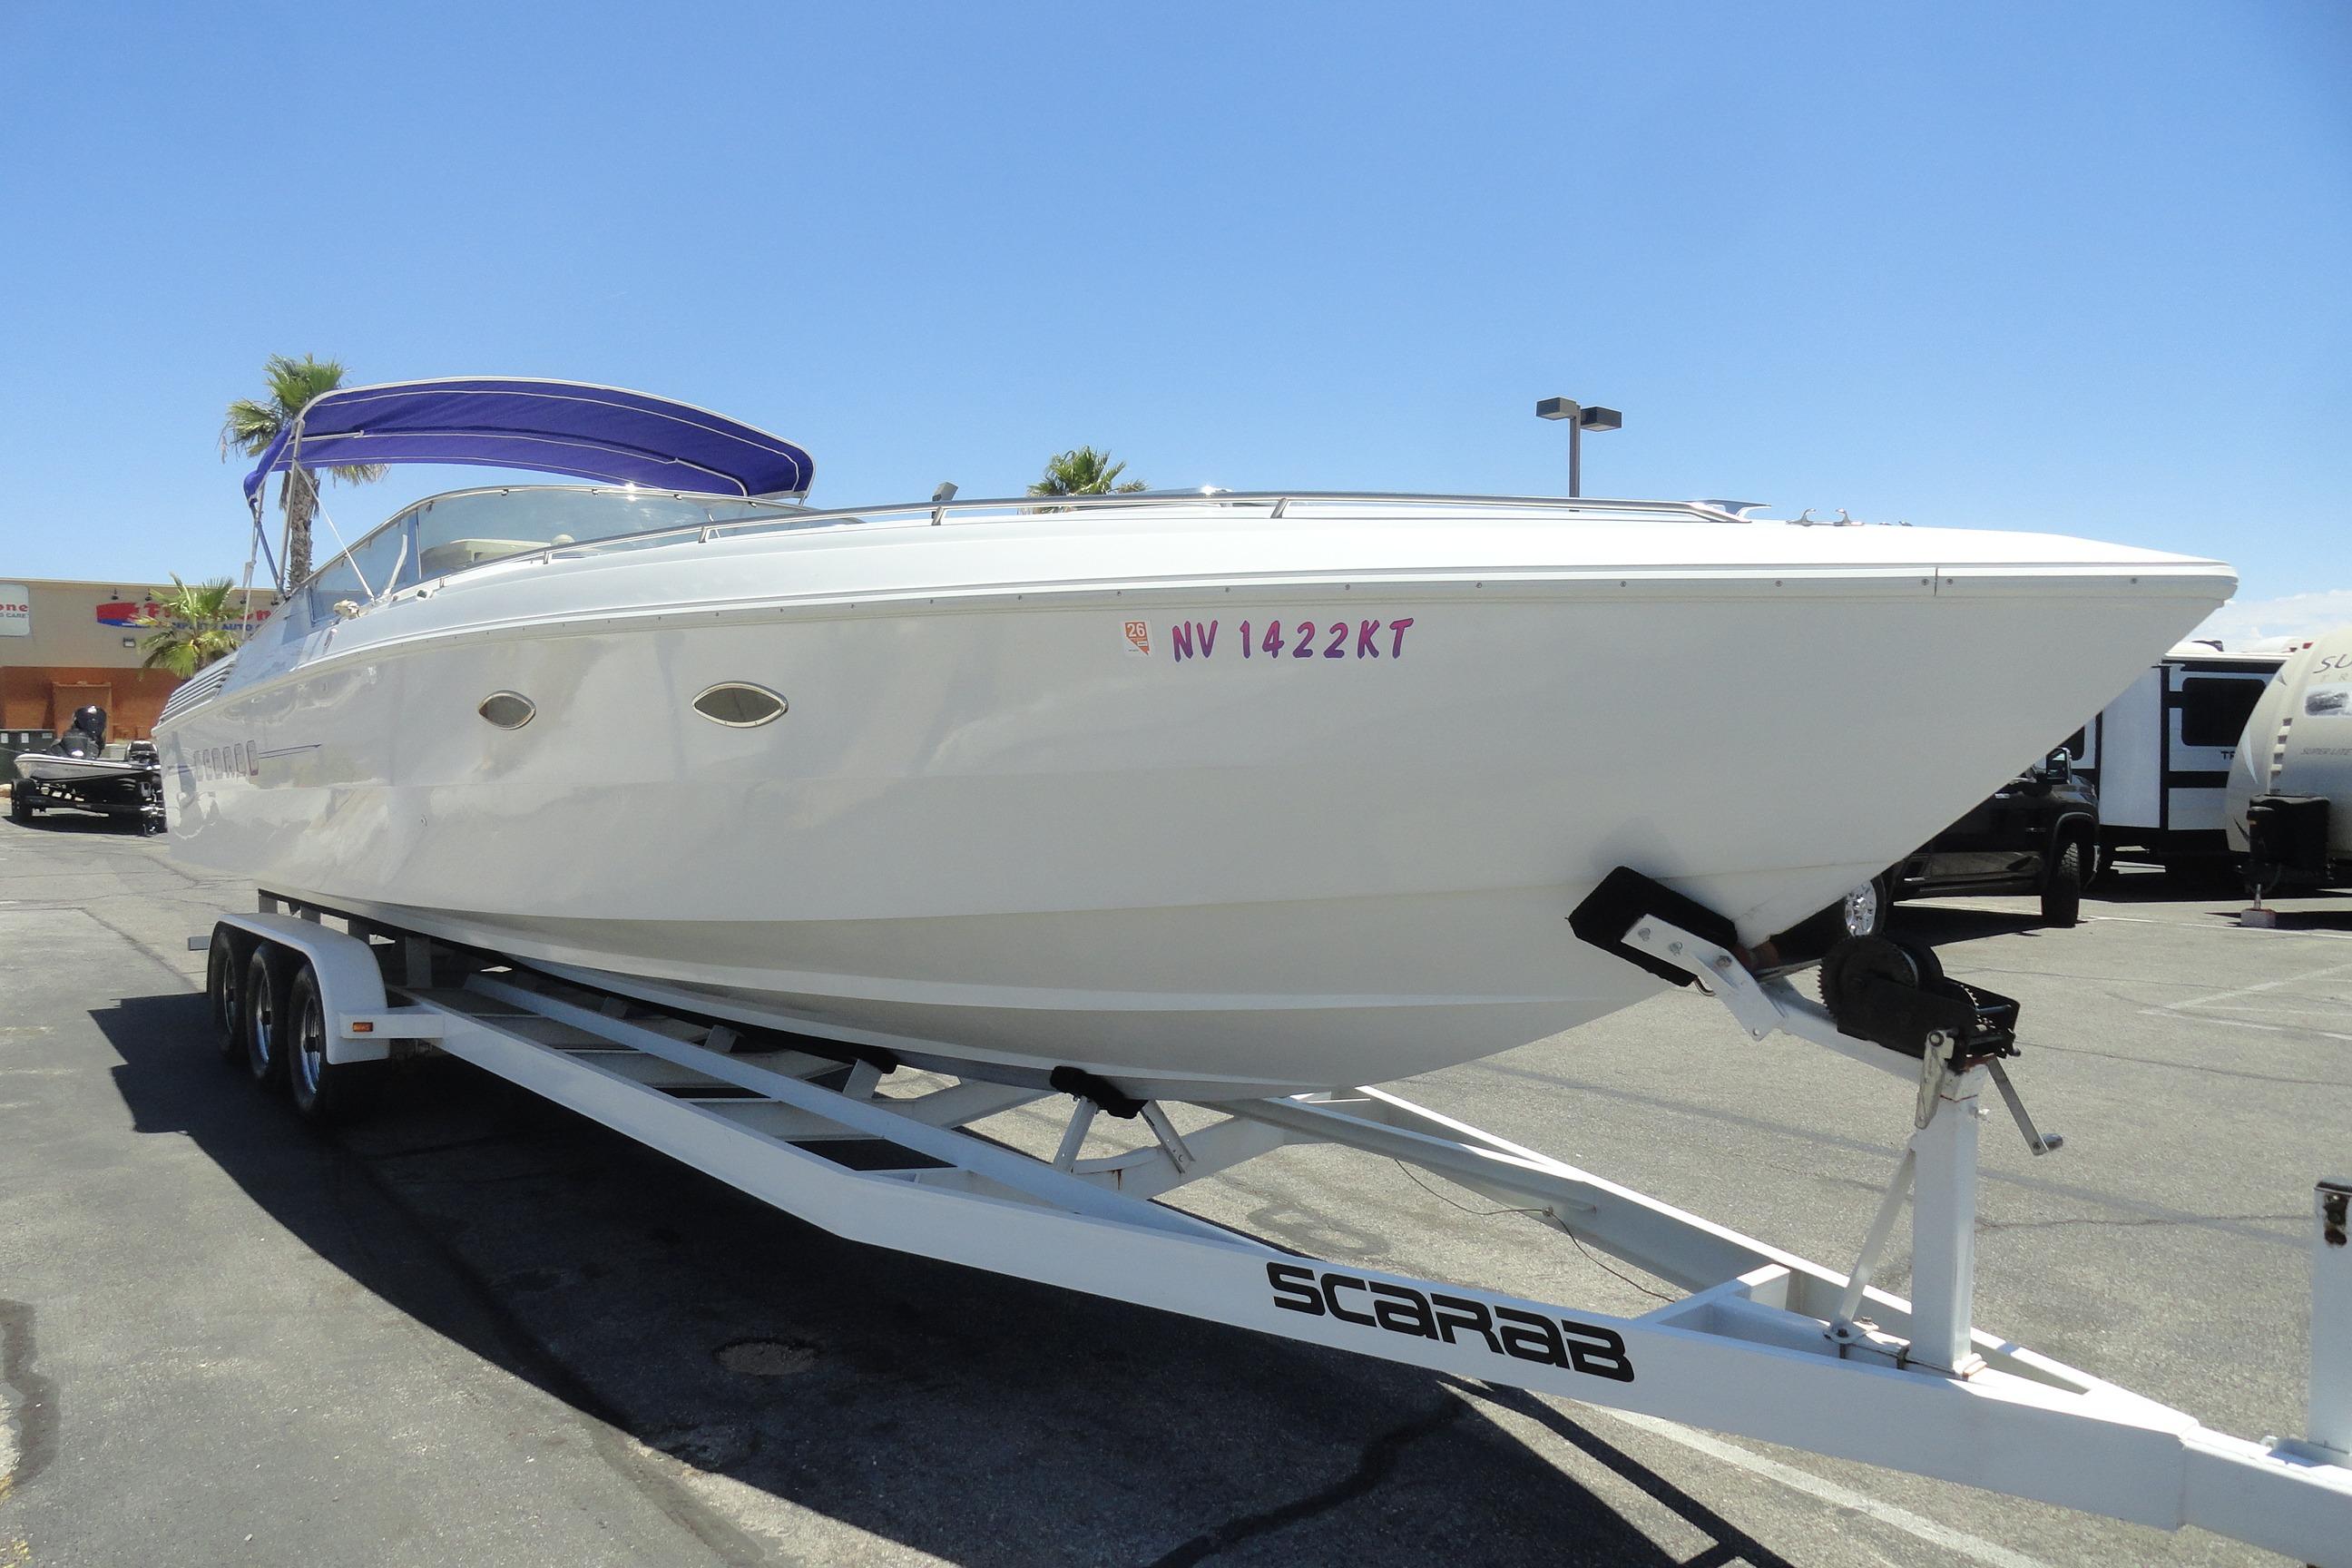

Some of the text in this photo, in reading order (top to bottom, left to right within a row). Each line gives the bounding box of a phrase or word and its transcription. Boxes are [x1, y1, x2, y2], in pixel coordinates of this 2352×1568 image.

[221, 623, 253, 632] AUTO
[1127, 622, 1145, 637] 26
[1171, 617, 1414, 662] NV 1422KT
